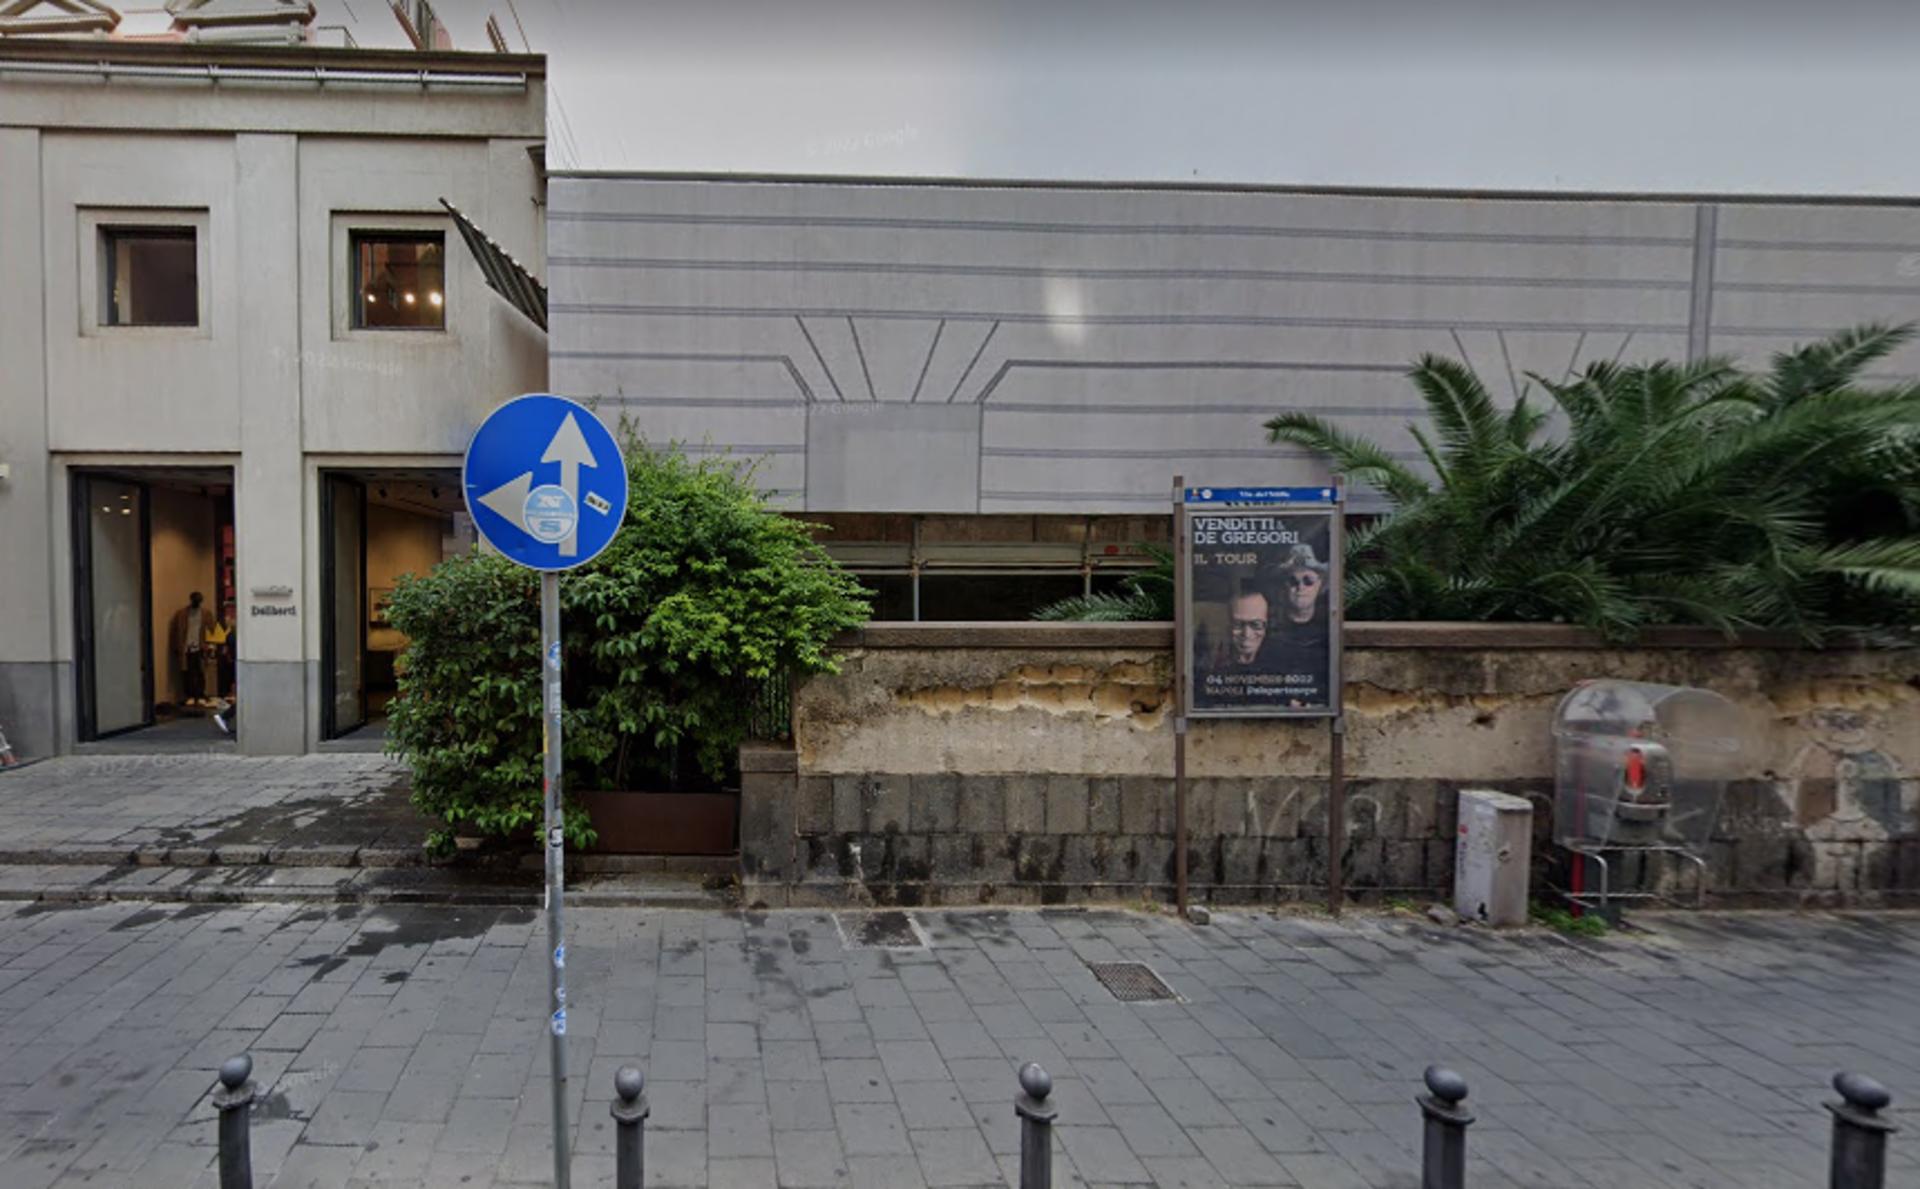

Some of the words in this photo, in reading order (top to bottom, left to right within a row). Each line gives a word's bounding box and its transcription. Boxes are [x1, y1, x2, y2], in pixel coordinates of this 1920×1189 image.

[1194, 531, 1217, 545] DE
[1222, 531, 1299, 545] GREGORI
[1194, 553, 1209, 565] IL
[1215, 553, 1258, 565] TOUR
